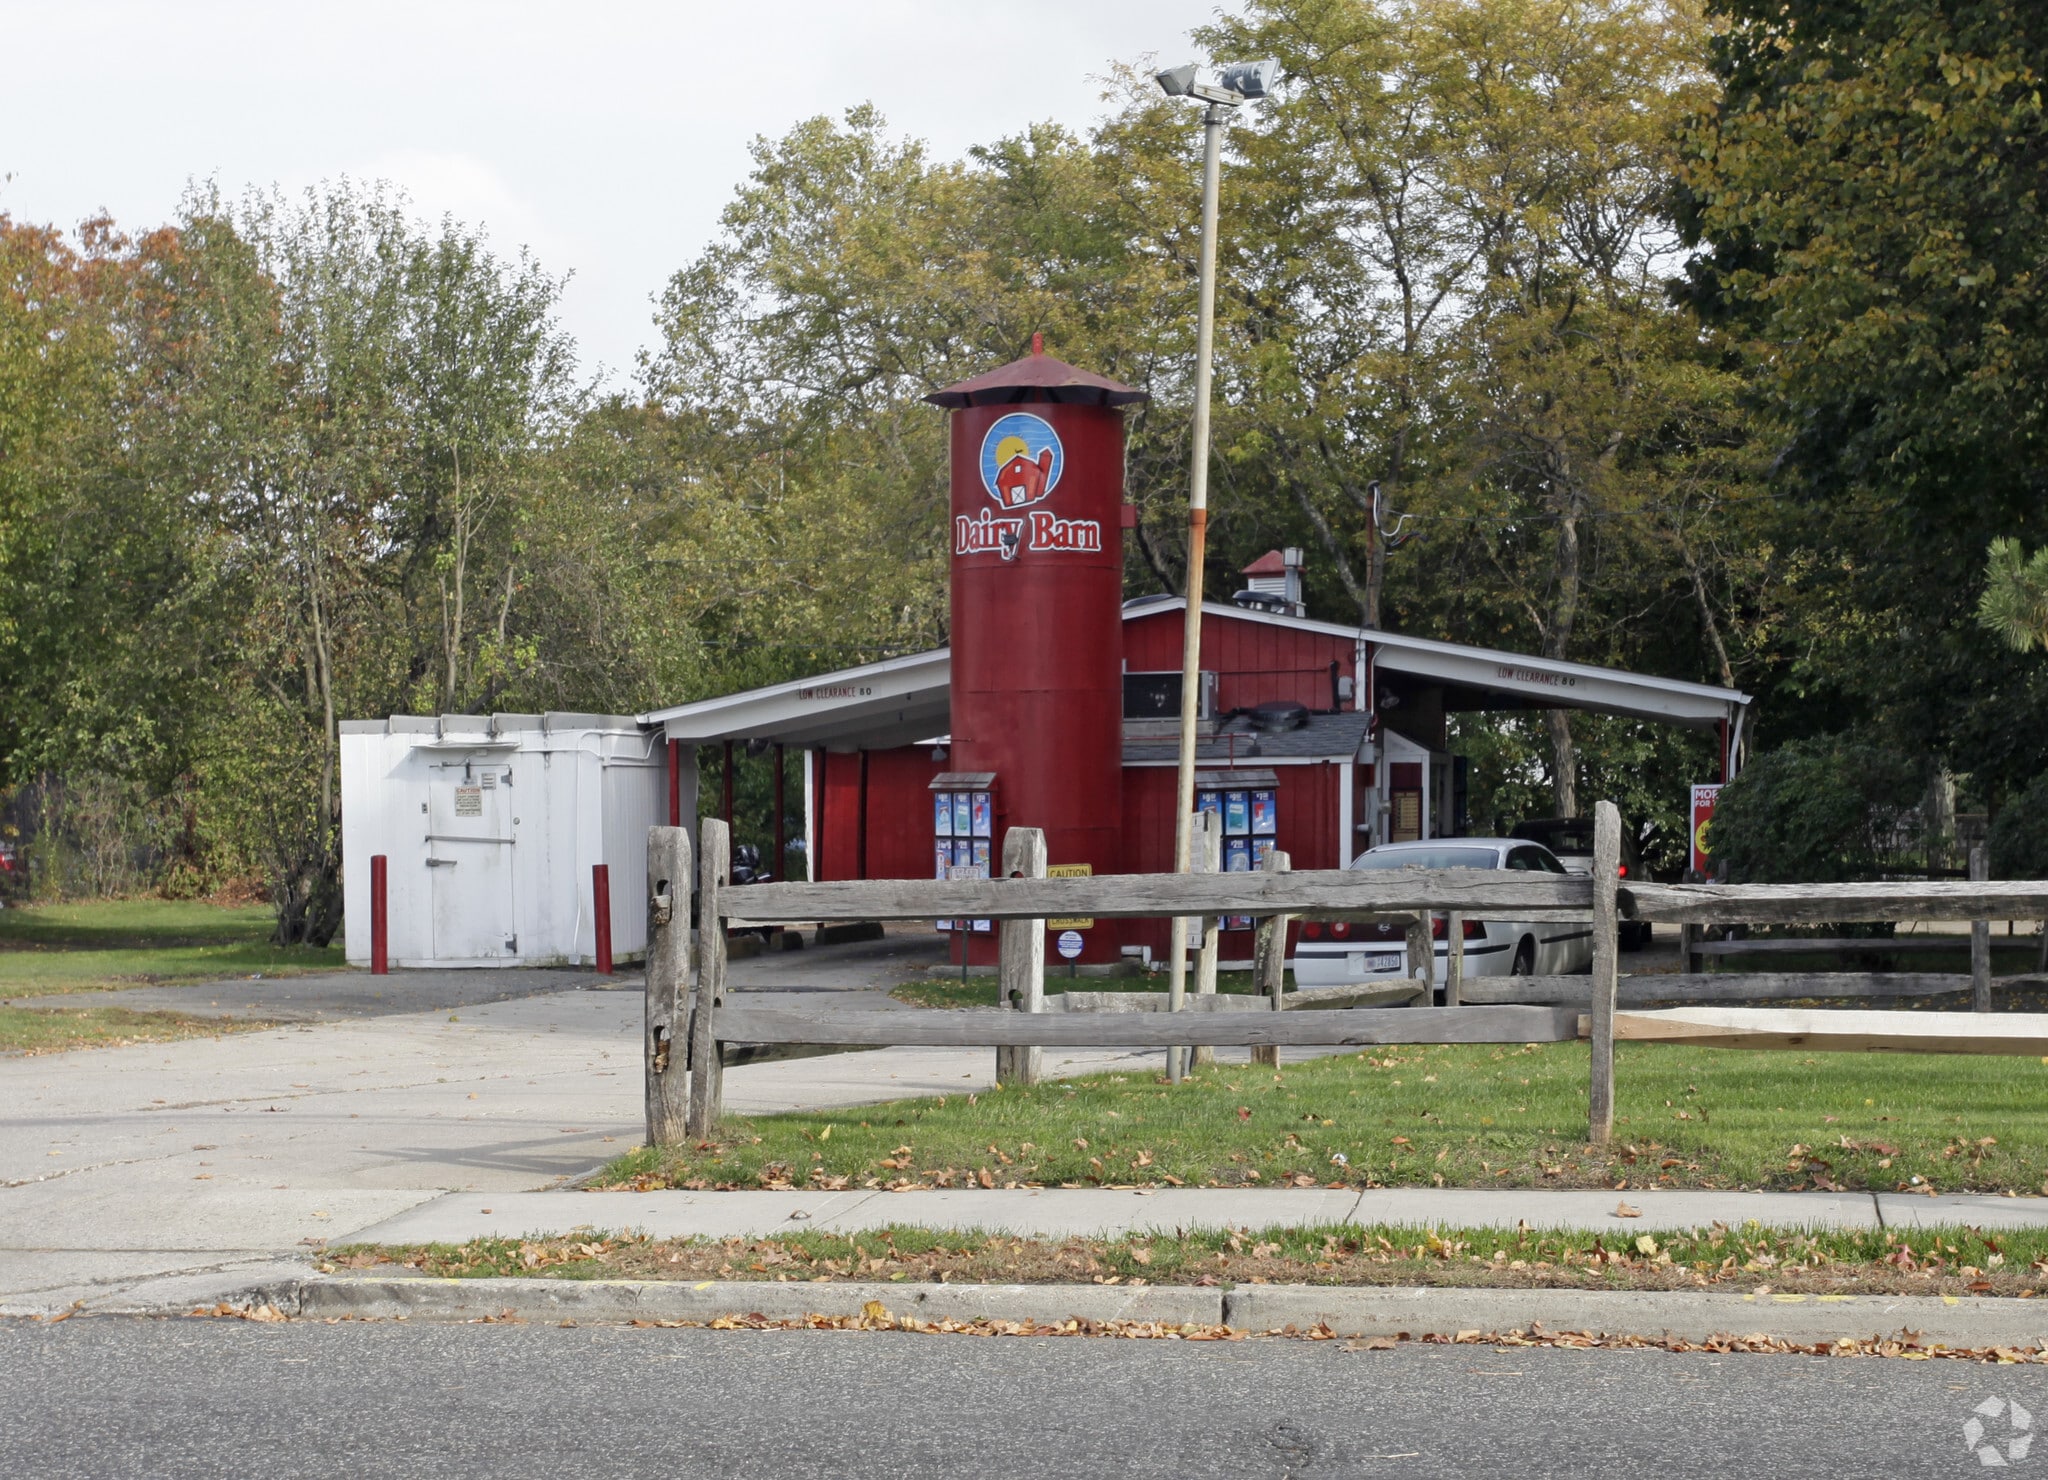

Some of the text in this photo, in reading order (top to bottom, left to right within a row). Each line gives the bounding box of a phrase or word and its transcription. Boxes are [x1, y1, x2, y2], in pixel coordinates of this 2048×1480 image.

[956, 507, 1101, 560] Dairy Barn
[1498, 667, 1514, 679] LOW
[1516, 669, 1559, 686] CLEARANCE
[799, 688, 814, 700] LOW
[816, 686, 856, 699] CLEARANCE
[1695, 800, 1711, 808] FOR
[1050, 868, 1088, 878] CAUTION
